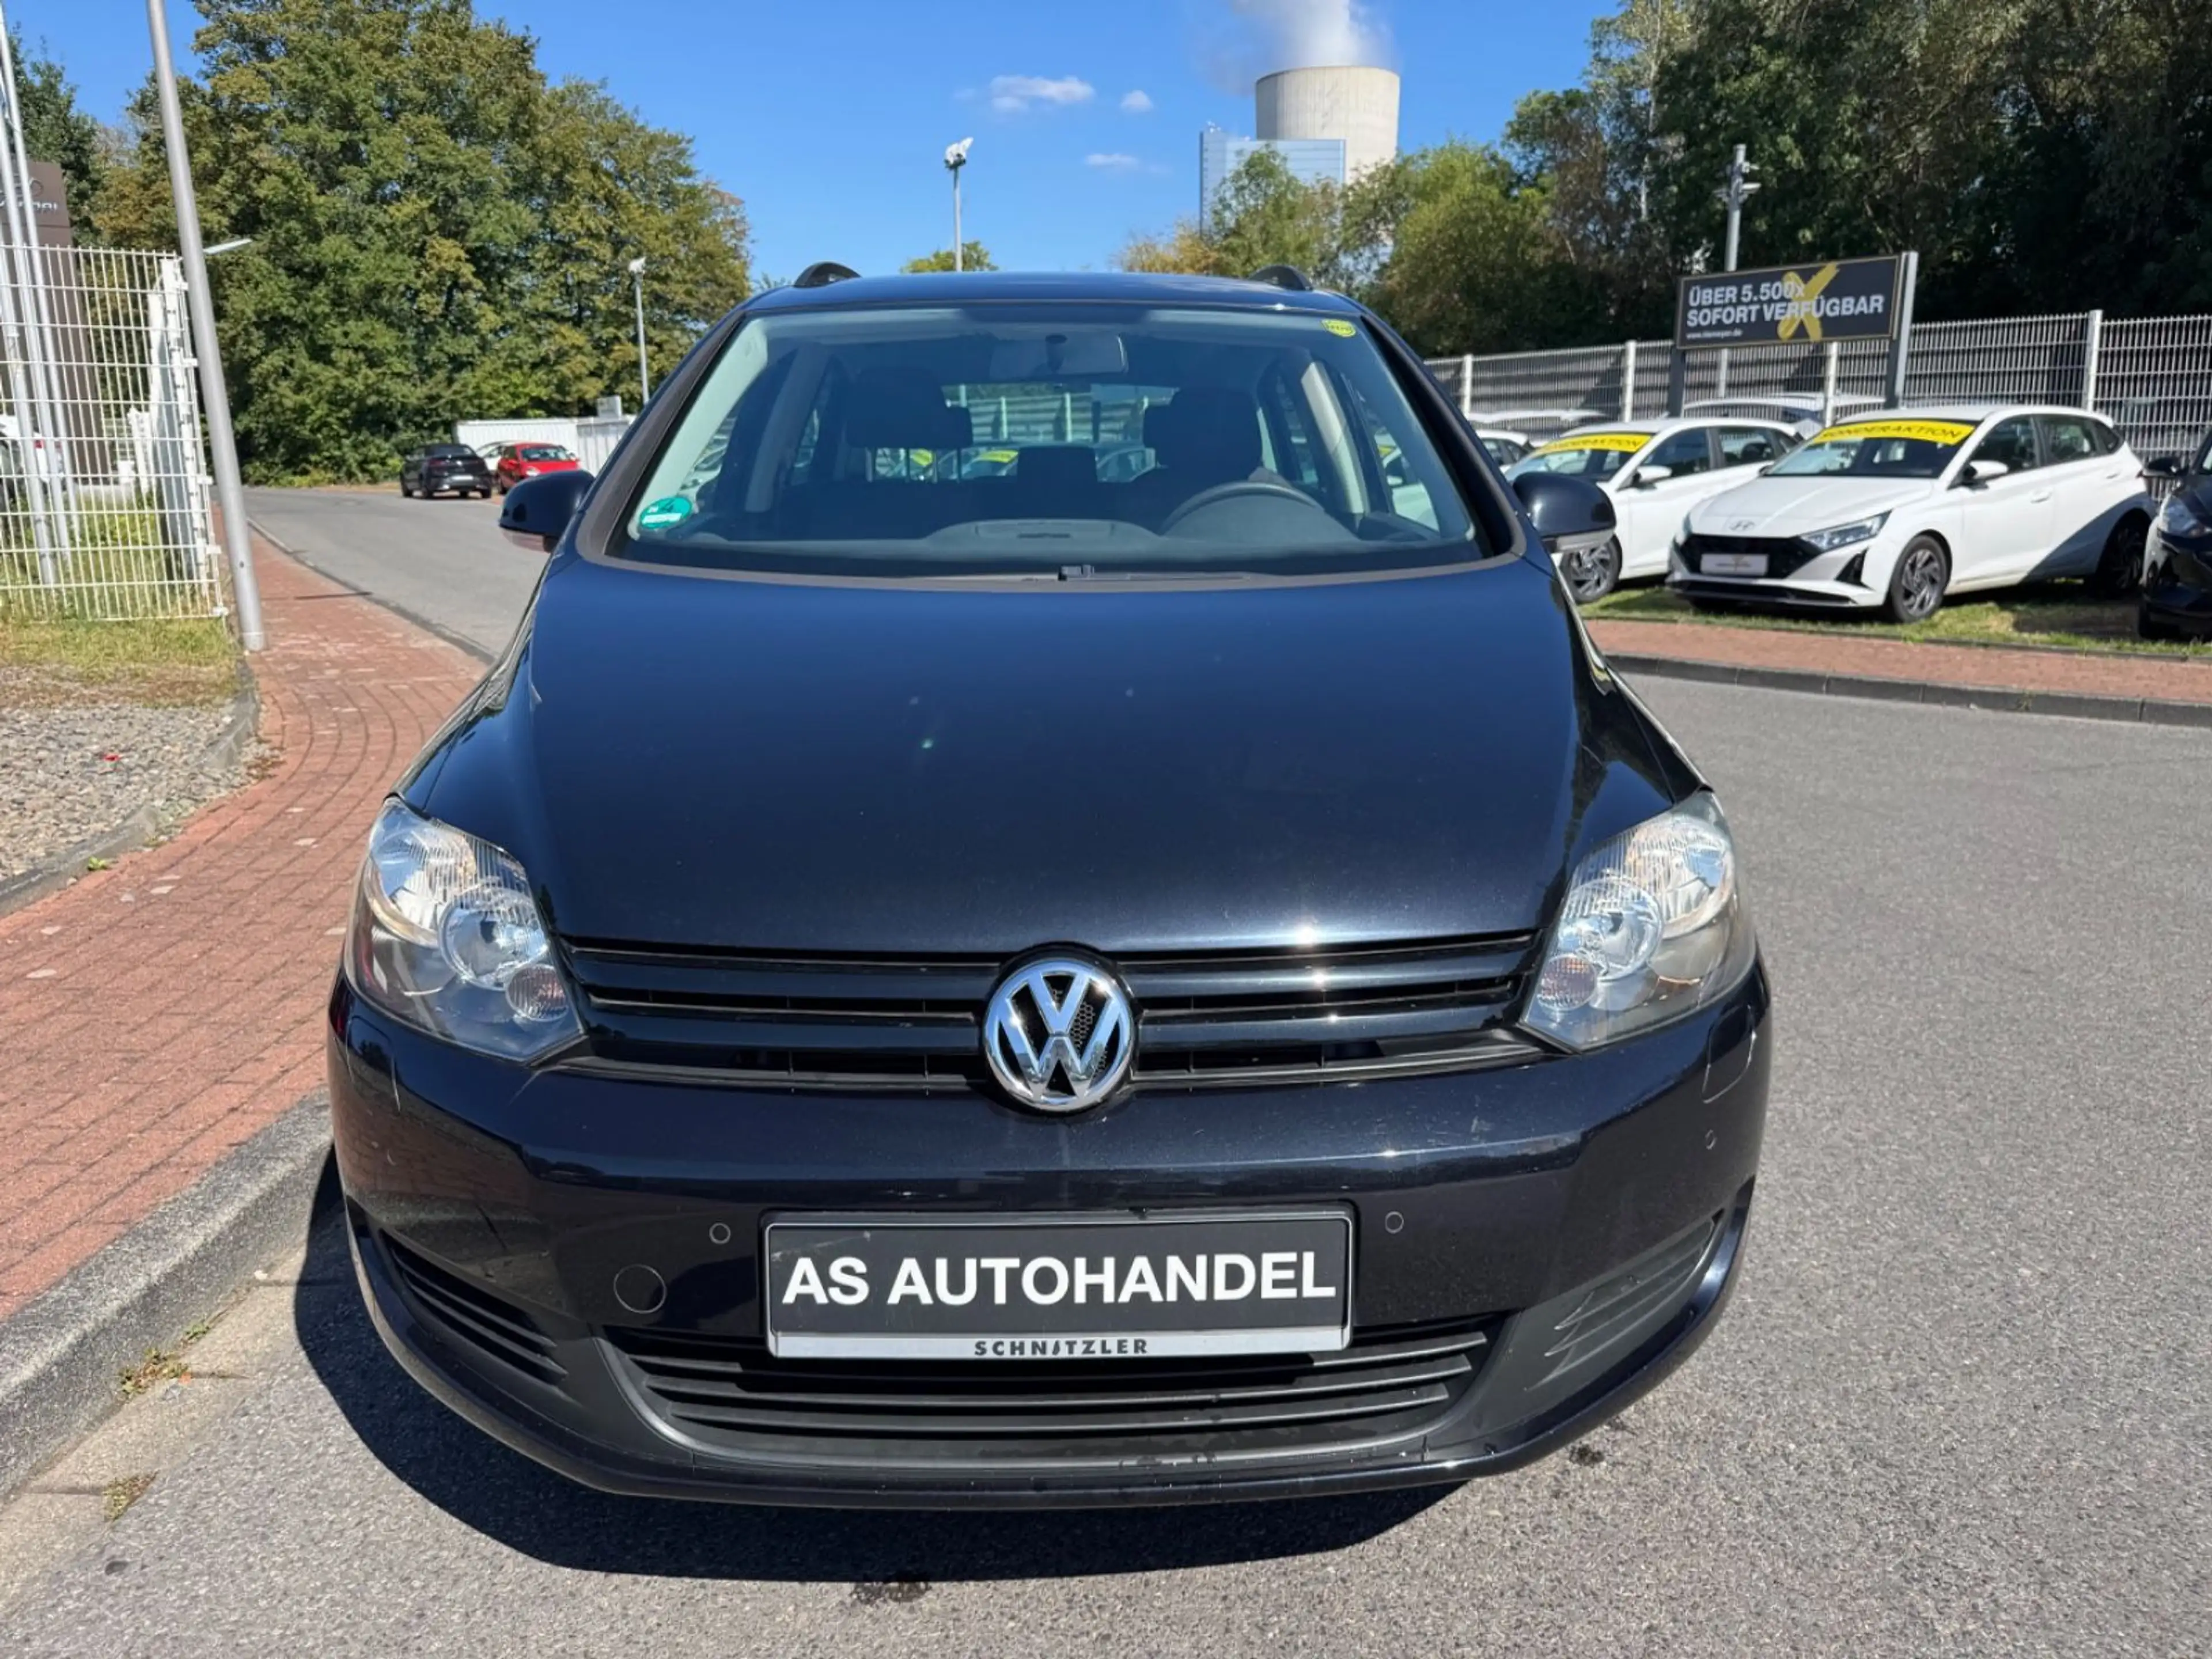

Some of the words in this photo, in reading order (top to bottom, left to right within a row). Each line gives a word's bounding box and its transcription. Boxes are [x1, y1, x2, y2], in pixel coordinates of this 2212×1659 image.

[1687, 304, 1759, 327] SOFORT
[1762, 294, 1884, 321] VERFÜGBAR
[1688, 285, 1737, 307] ÜBER
[985, 958, 1132, 1111] VW
[782, 1256, 870, 1305] AS
[887, 1251, 1336, 1305] AUTOHANDEL
[974, 1339, 1147, 1356] SCHNITZLER
